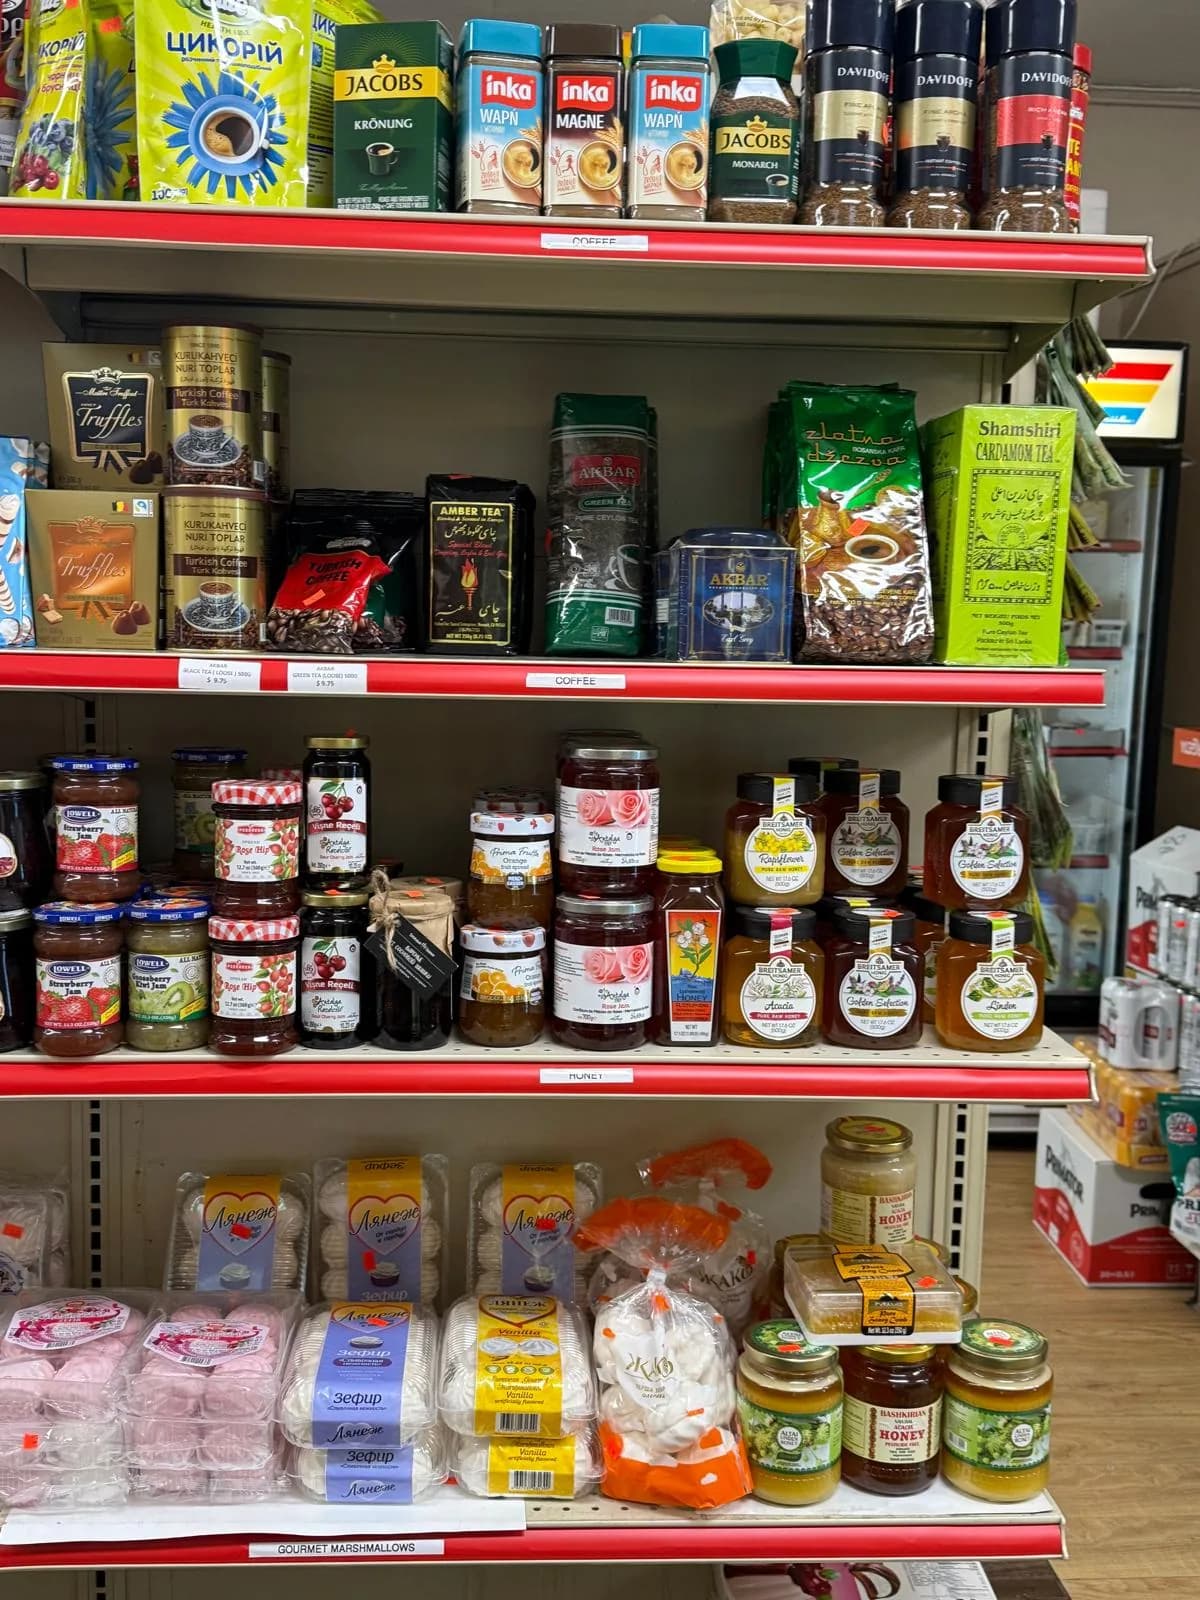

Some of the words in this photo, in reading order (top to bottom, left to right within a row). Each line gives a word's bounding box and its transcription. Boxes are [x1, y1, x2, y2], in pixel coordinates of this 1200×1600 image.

[167, 31, 283, 65] ЦИКОРІЙ
[837, 66, 890, 85] DAVIDOFF
[917, 75, 974, 89] DAVIDOFF
[345, 74, 423, 97] JACOBS
[486, 75, 532, 101] inka
[562, 79, 609, 102] inka
[650, 79, 697, 103] inka
[354, 117, 413, 130] KRÖNUNG
[480, 108, 519, 126] WAPŃ
[644, 111, 683, 129] WAPŃ
[720, 132, 791, 150] JACOBS
[732, 160, 779, 171] MONARCH
[76, 403, 144, 440] Truffles
[805, 422, 905, 446] zlatna
[978, 420, 1061, 439] Shamshiri
[578, 465, 636, 480] AKBAR
[584, 498, 613, 508] GREEN
[440, 506, 478, 517] AMBER
[481, 507, 502, 517] TEA
[209, 533, 246, 543] TOPLAR
[185, 556, 218, 567] Turkish
[219, 557, 249, 569] Coffee
[58, 552, 128, 590] Truffles
[709, 572, 768, 587] AKBAR
[555, 676, 597, 686] COFFEE
[63, 824, 105, 834] Strawberry
[762, 821, 803, 829] BREITSAMER
[76, 832, 93, 841] Jam
[503, 857, 528, 865] Orange
[53, 964, 88, 973] LOWELL
[136, 959, 167, 968] LOWELL
[857, 963, 901, 971] BREITSAMER
[49, 981, 94, 991] Strawberry
[65, 988, 82, 996] Jam
[151, 982, 168, 990] Jam
[677, 992, 708, 1001] HONEY
[846, 996, 874, 1007] Golden
[875, 998, 909, 1008] Selection
[764, 1001, 794, 1011] Acacia
[986, 1000, 1017, 1011] Linden
[1045, 1144, 1085, 1202] PRIMATOR
[203, 1206, 277, 1234] Лянеж
[349, 1206, 421, 1236] Лянеж
[879, 1210, 913, 1225] HONEY
[337, 1349, 392, 1358] Зефир
[333, 1392, 383, 1406] Зефир
[506, 1391, 534, 1400] Vanilla
[327, 1424, 385, 1443] Лянеж
[782, 1429, 799, 1437] ALTAI
[880, 1429, 925, 1441] HONEY
[346, 1450, 395, 1465] Зефир
[519, 1448, 548, 1457] Vanilla
[341, 1482, 397, 1499] Лянеж
[277, 1544, 329, 1555] GOURMET
[330, 1542, 417, 1554] MARSHMALLOWS
